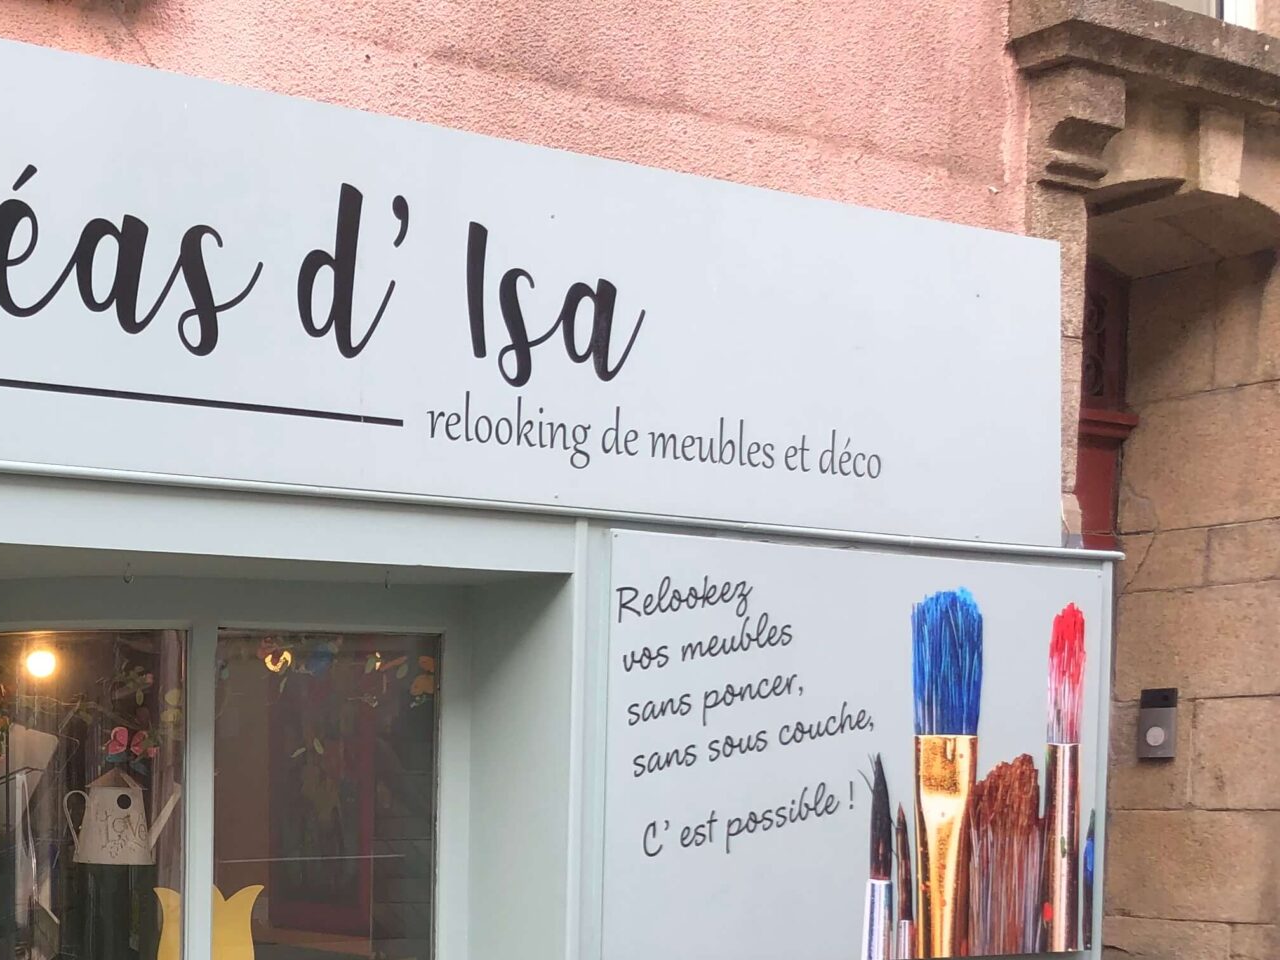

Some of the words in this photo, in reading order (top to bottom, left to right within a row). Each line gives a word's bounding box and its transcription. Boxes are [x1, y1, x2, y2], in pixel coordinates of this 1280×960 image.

[466, 221, 646, 388] Isa
[426, 390, 592, 470] relooking
[601, 405, 639, 457] de
[647, 416, 775, 469] meubles
[784, 434, 811, 473] et
[818, 429, 882, 479] déco
[616, 575, 754, 624] Relookez
[622, 645, 670, 673] vos
[681, 612, 794, 662] meubles
[627, 692, 692, 727] sans
[702, 673, 804, 727] poncer,
[633, 743, 697, 778] sans
[708, 729, 768, 763] sous
[778, 701, 875, 746] couche,
